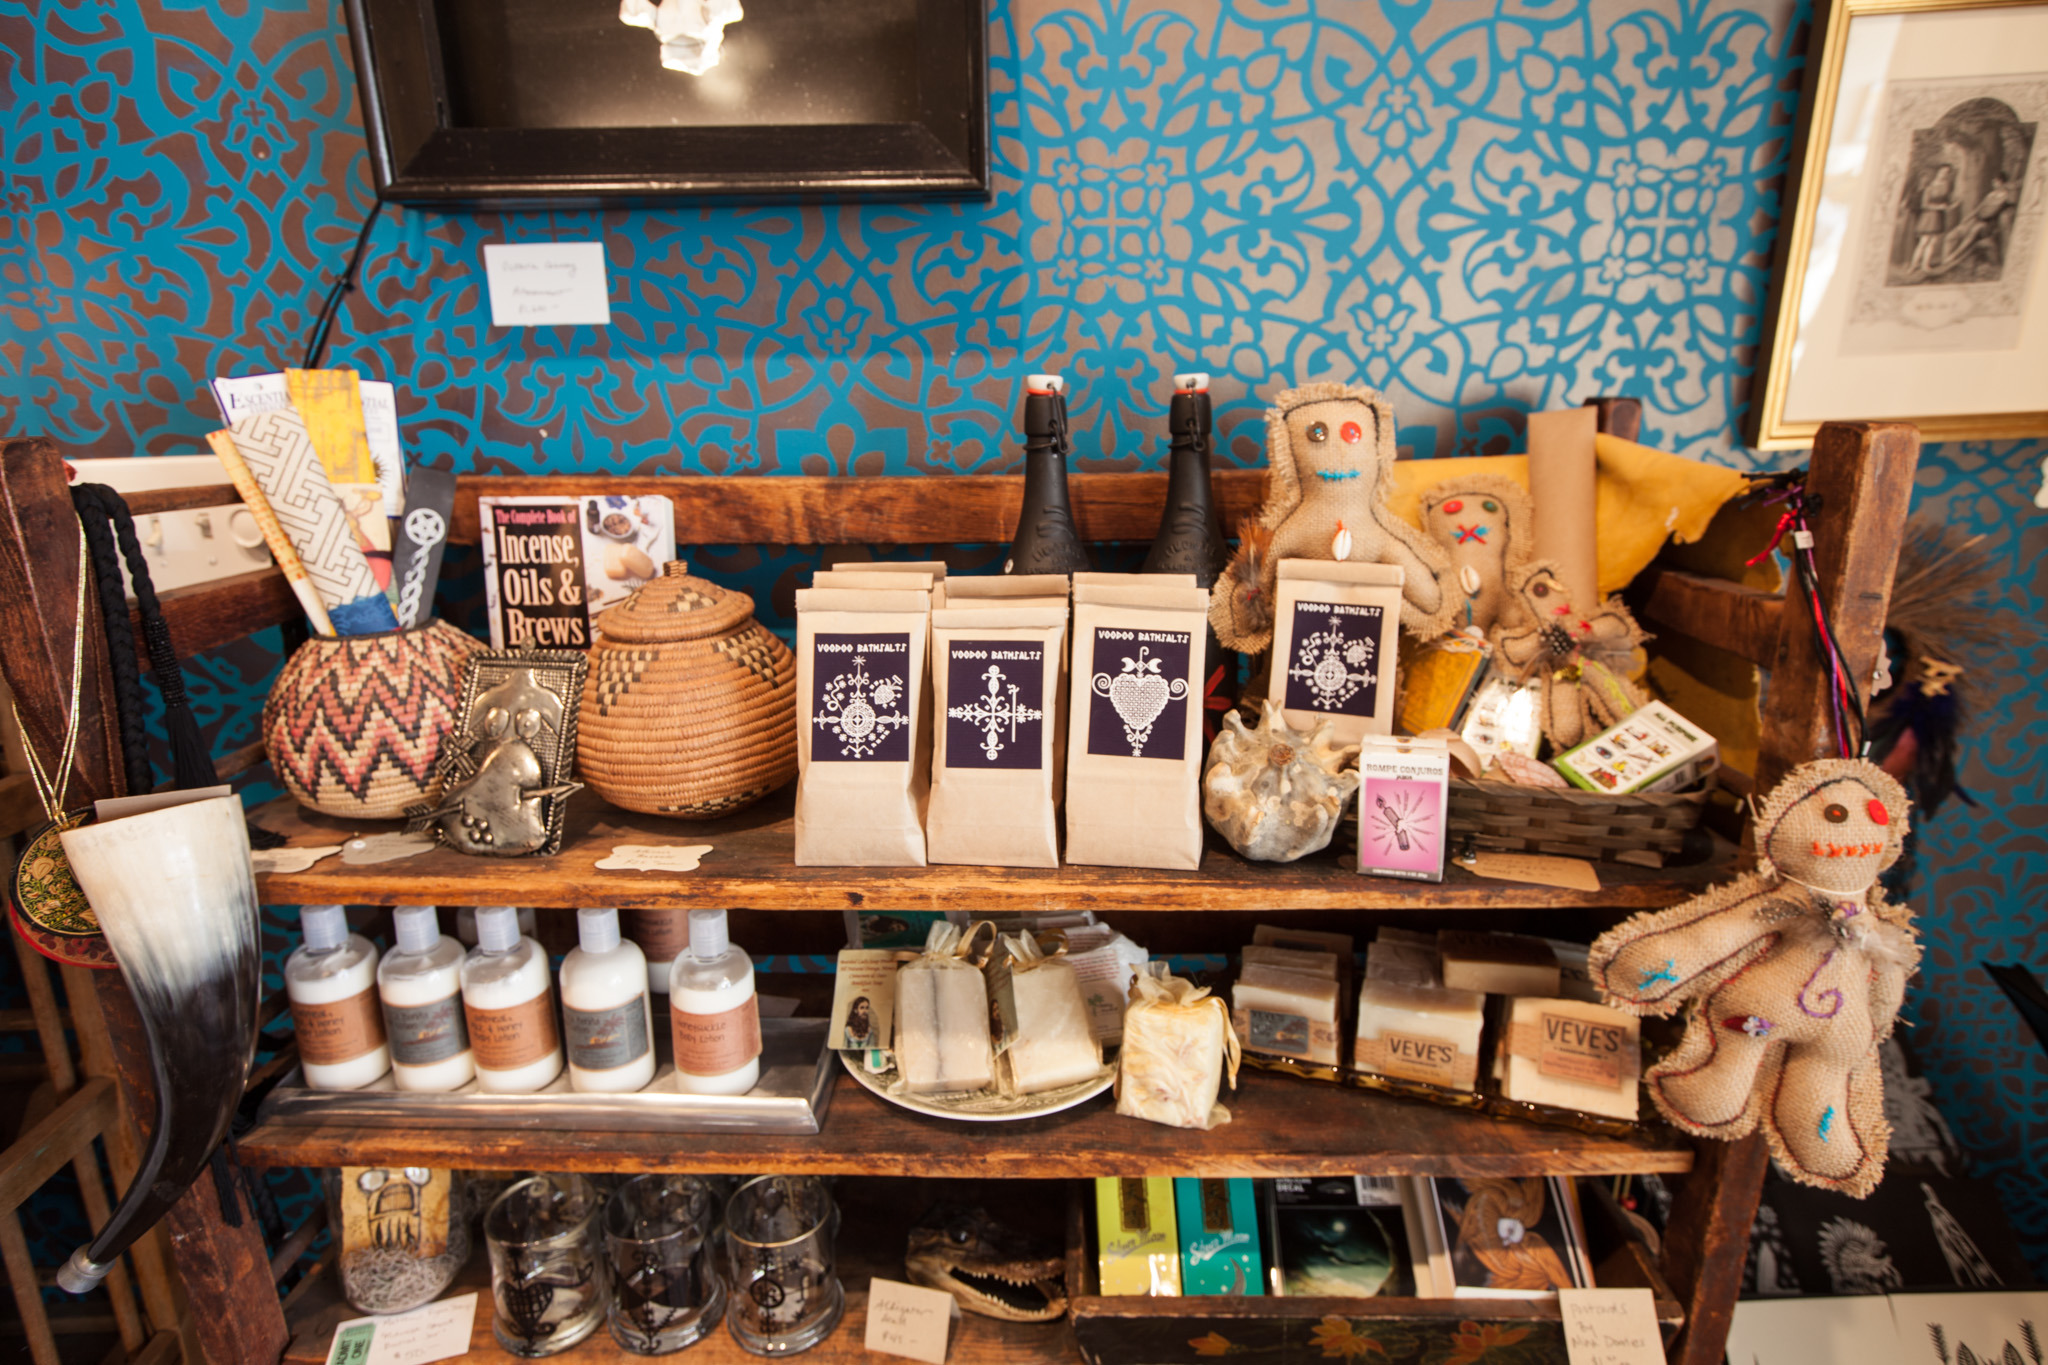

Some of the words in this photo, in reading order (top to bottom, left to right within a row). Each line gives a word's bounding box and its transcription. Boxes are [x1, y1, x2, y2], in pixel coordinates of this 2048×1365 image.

[495, 509, 509, 523] The
[510, 510, 546, 526] Complete
[546, 509, 565, 523] Book
[566, 509, 577, 524] of
[498, 526, 580, 567] Incense,
[503, 568, 554, 606] Oils
[558, 568, 582, 606] &
[1297, 602, 1331, 613] VOODOO
[506, 608, 586, 646] Brews
[1098, 630, 1135, 640] VOODOO
[1138, 632, 1189, 644] BATHSALTS
[817, 643, 854, 653] VOODOO
[856, 643, 908, 653] BATHSALTS
[951, 650, 988, 660] VOODOO
[991, 651, 1042, 660] BATHSALTS
[1366, 763, 1398, 773] ROMPE
[1400, 766, 1444, 776] CONJUROS
[1546, 1018, 1620, 1052] VEVE'S
